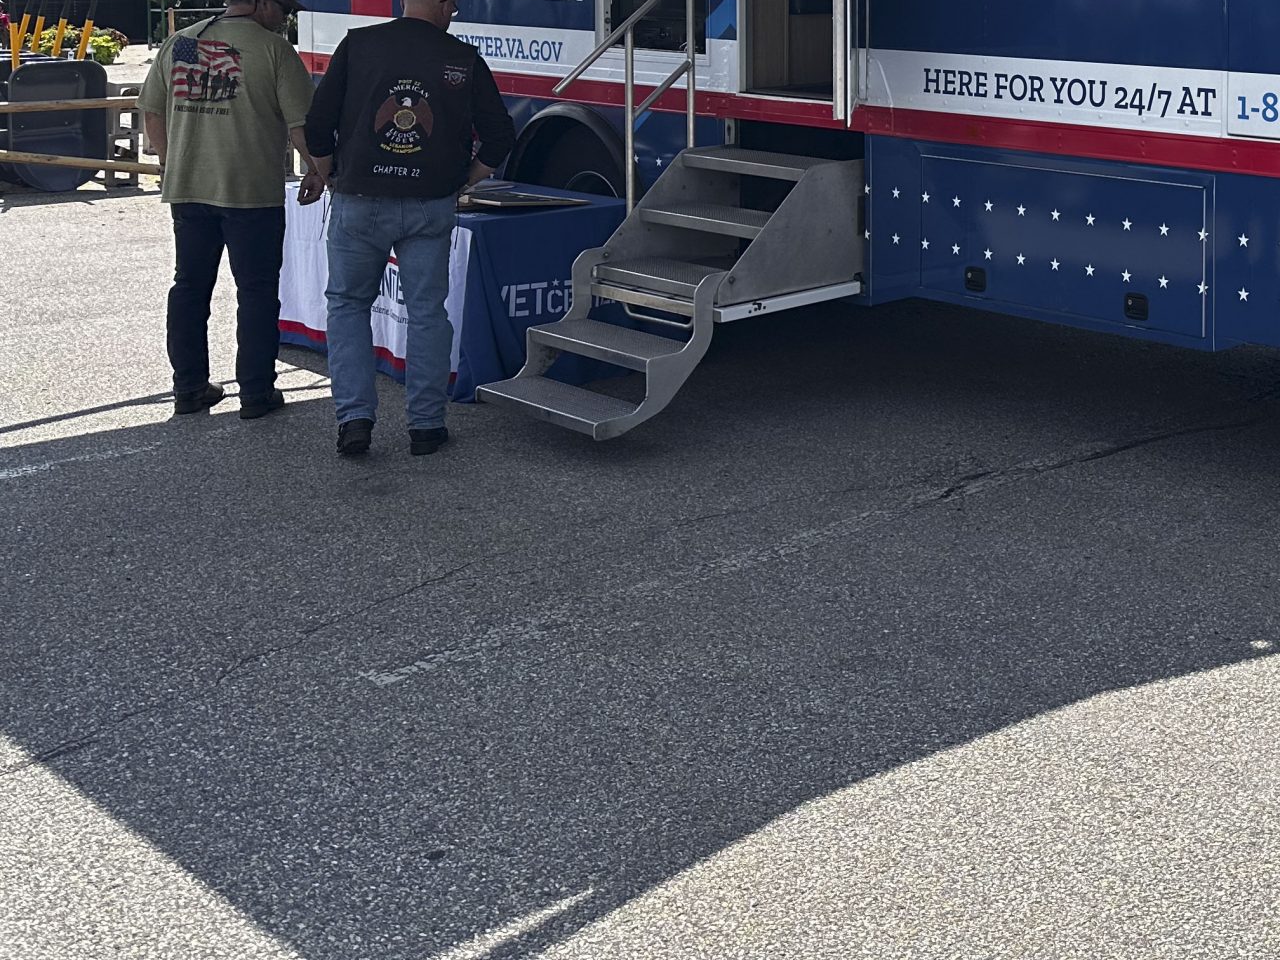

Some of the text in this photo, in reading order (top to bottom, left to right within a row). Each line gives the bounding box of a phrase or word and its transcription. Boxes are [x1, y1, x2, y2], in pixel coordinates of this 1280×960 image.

[923, 68, 988, 98] HERE
[994, 73, 1045, 102] FOR
[1050, 77, 1107, 107] YOU
[1114, 83, 1172, 117] 24/7
[1177, 87, 1217, 116] AT
[373, 164, 420, 177] CHAPTER 22
